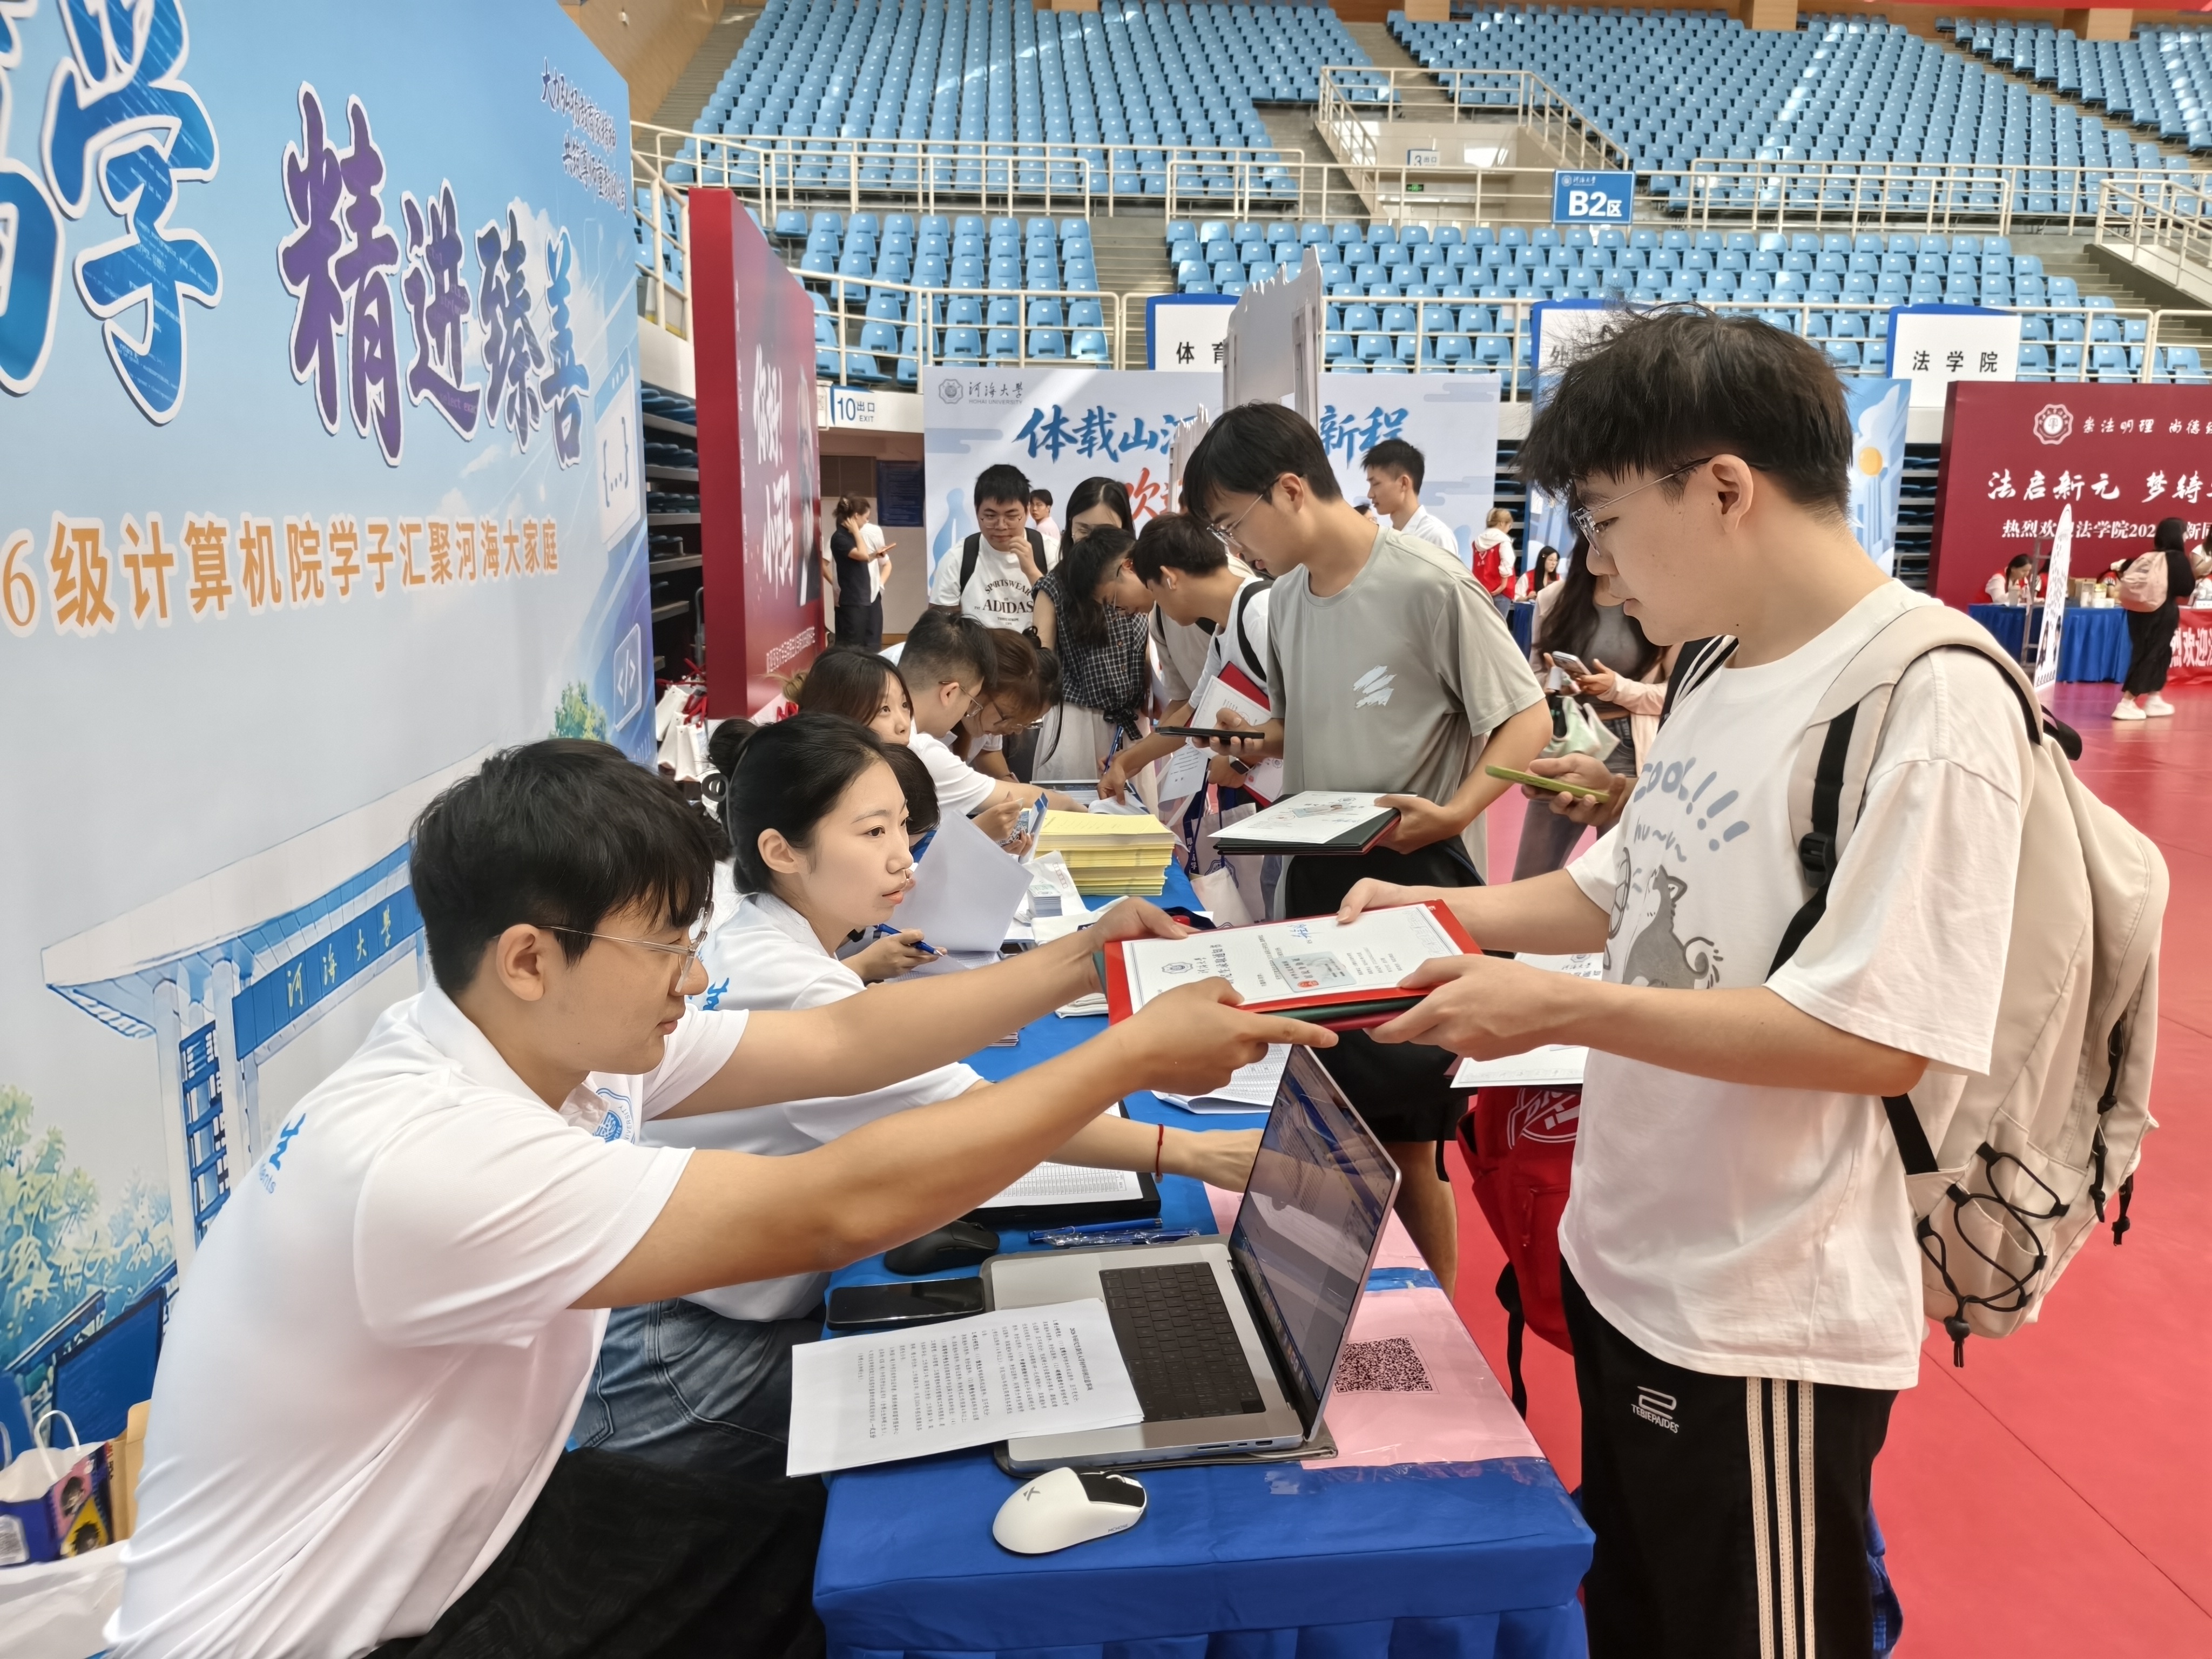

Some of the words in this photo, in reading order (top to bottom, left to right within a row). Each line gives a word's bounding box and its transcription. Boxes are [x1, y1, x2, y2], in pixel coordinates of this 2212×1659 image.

[1569, 190, 1622, 217] B2区
[1912, 351, 1998, 373] 法学院
[837, 397, 856, 421] 10
[857, 401, 875, 413] 出口
[2083, 416, 2154, 434] 崇法明理
[1987, 469, 2120, 501] 法启新元
[982, 599, 1034, 613] ADIDAS
